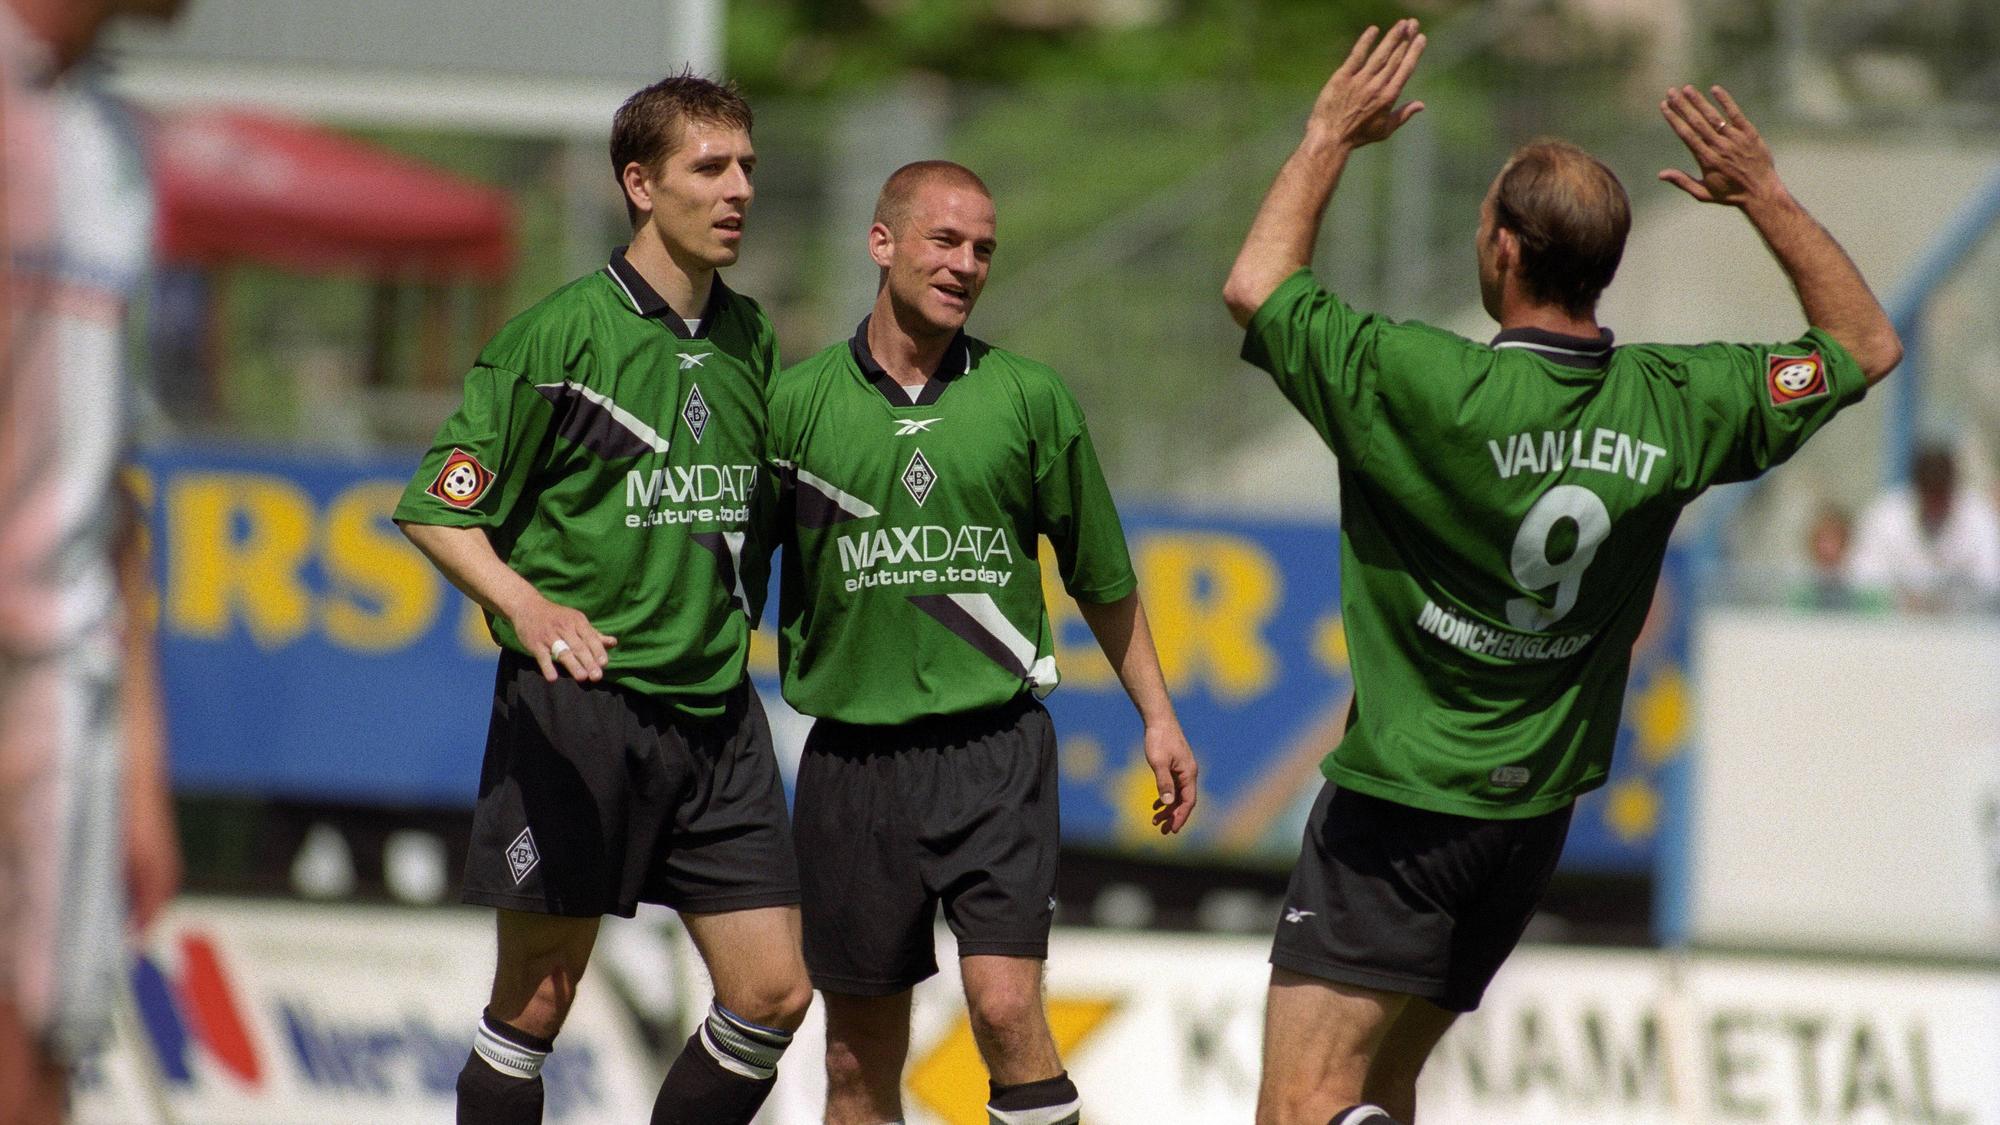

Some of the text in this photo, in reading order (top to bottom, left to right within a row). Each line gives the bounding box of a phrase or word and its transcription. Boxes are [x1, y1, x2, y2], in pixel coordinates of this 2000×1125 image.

[1488, 427, 1667, 485] VAN LENT
[626, 464, 758, 507] MAXDATA
[837, 525, 1013, 572] MAXDATA
[1507, 485, 1612, 632] 9
[1178, 990, 1970, 1124] KNAMETAL
